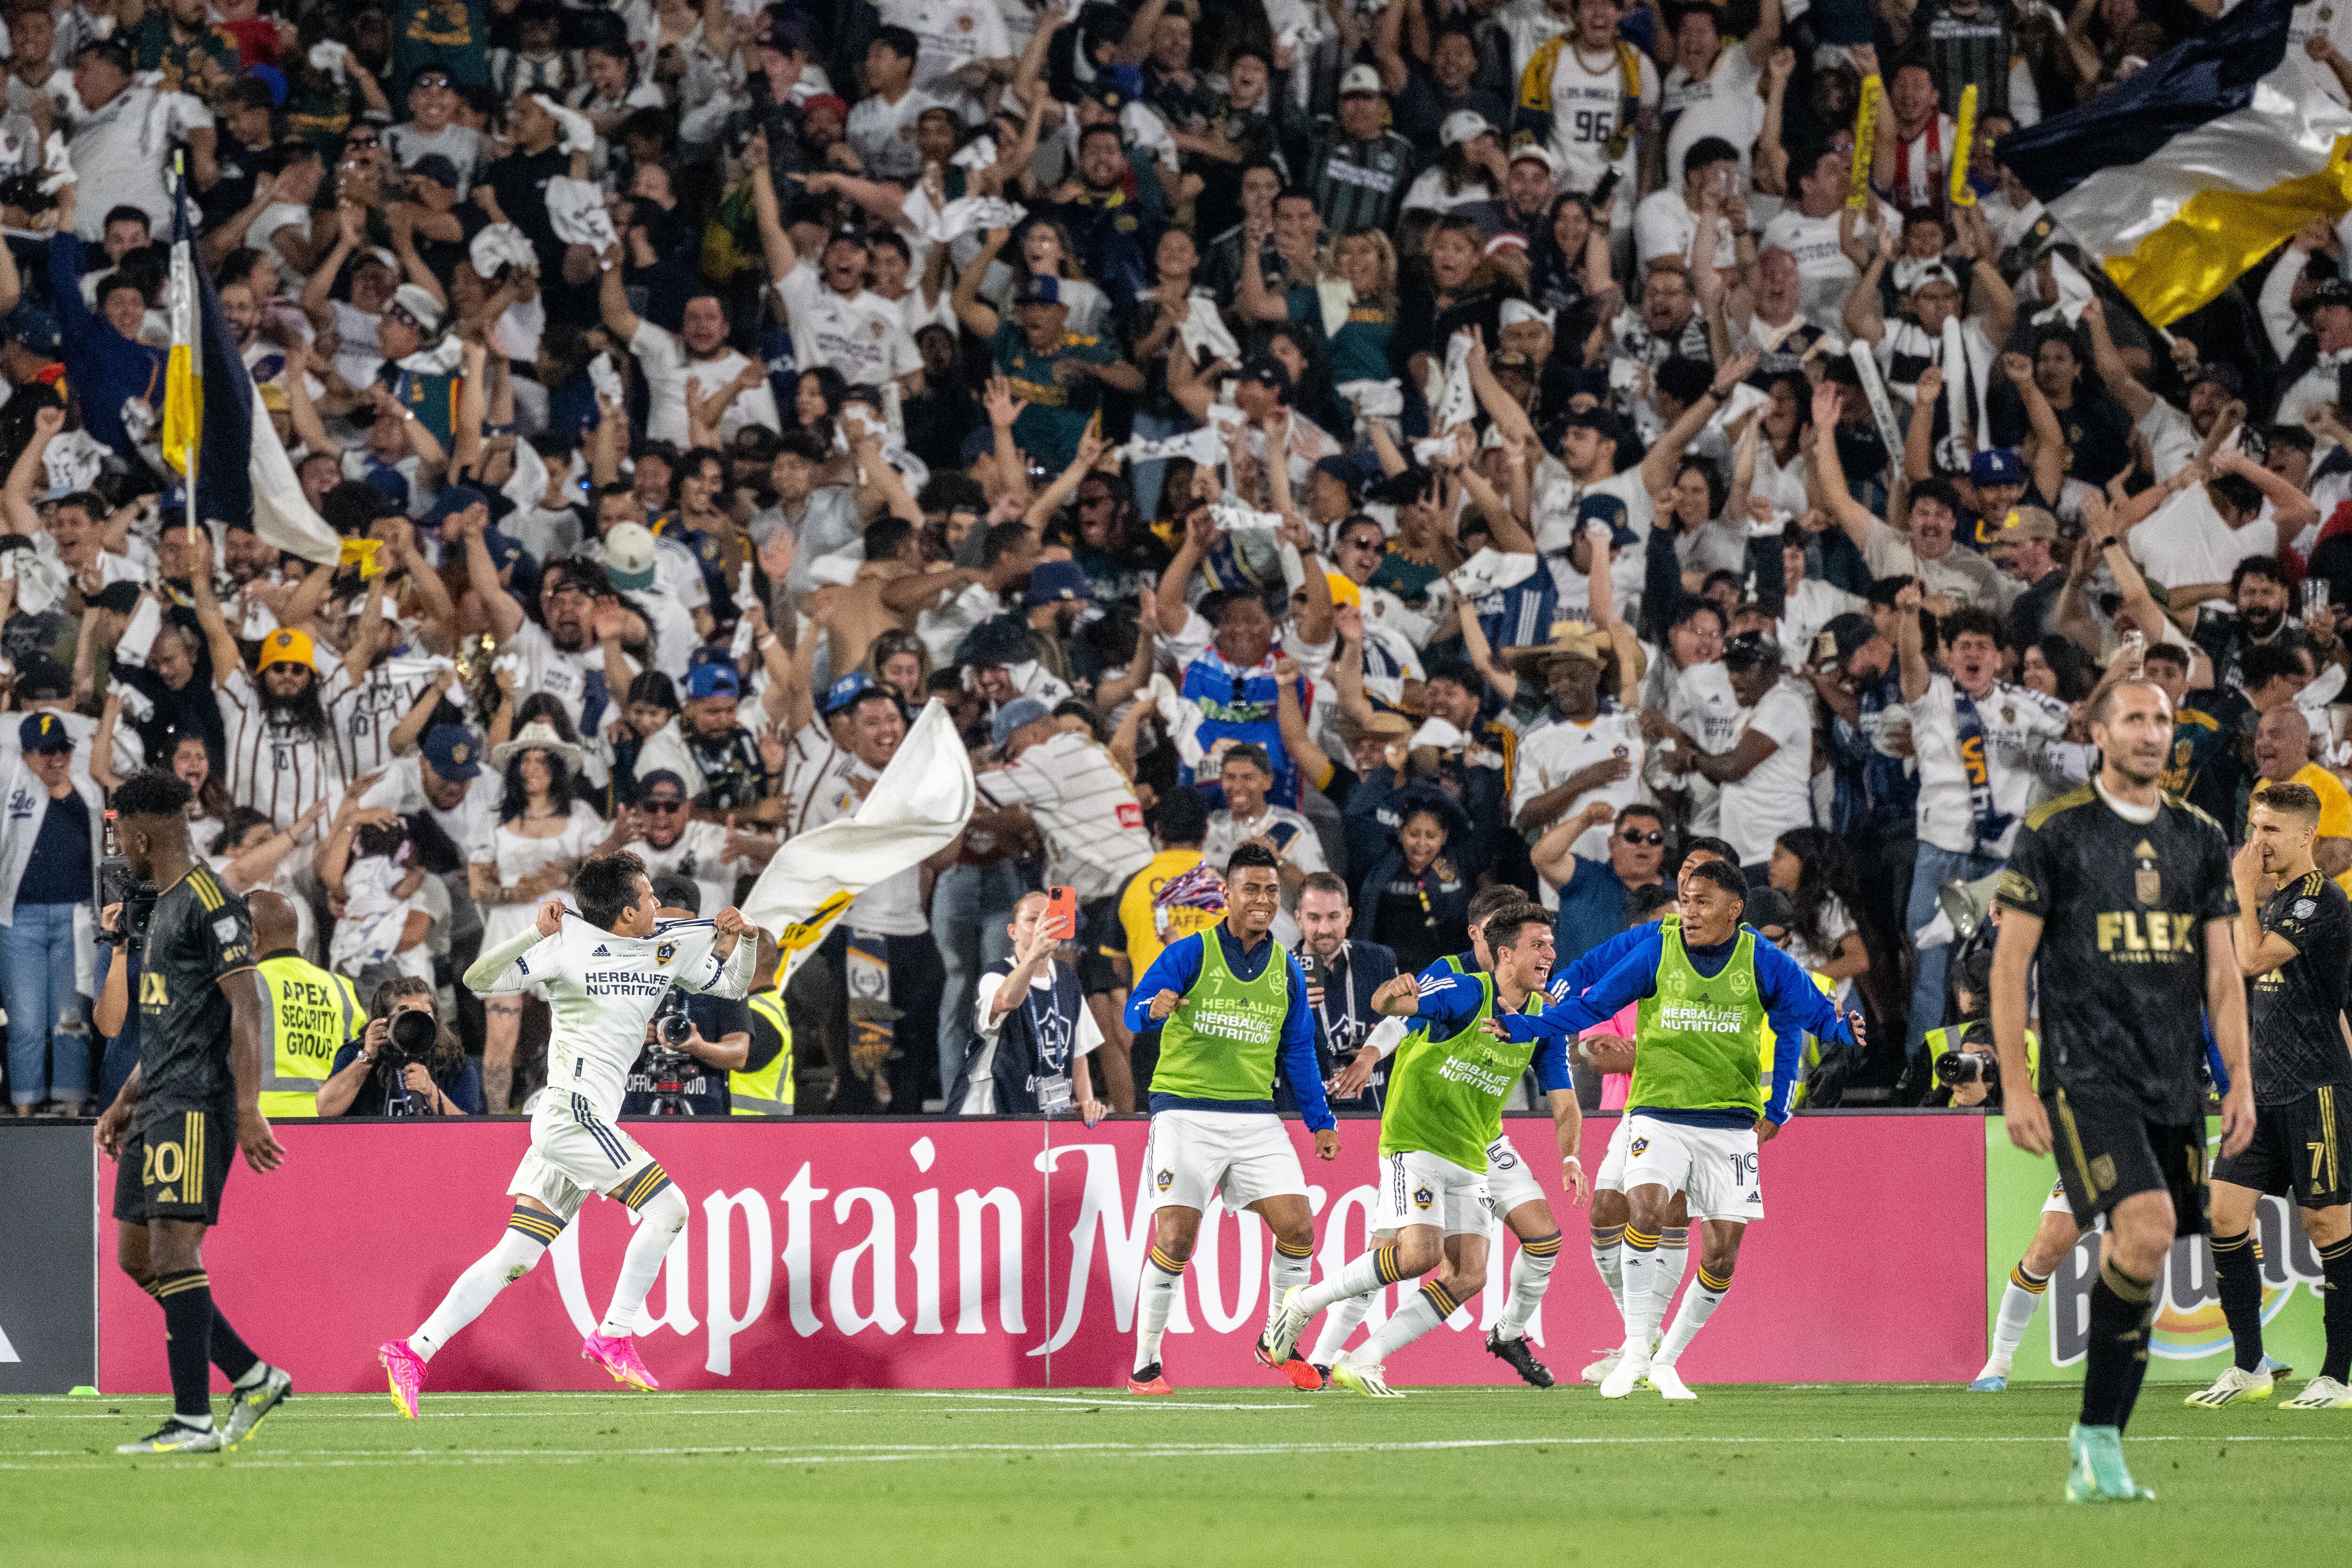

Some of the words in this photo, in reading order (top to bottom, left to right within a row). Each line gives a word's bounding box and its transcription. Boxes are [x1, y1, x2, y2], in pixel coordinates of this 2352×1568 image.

[1574, 110, 1613, 143] 96
[2097, 911, 2196, 954] FLEX
[659, 949, 670, 958] LA
[585, 971, 669, 986] HERBALIFE
[586, 984, 661, 996] NUTRITION
[1213, 979, 1223, 995] 7
[1733, 978, 1747, 987] LA
[283, 980, 332, 1008] APEX
[282, 1004, 337, 1035] SECURITY
[1195, 1010, 1274, 1034] HERBALIFE
[1661, 1018, 1741, 1034] NUTRITION
[1662, 1006, 1742, 1022] HERBALIFE
[286, 1031, 333, 1061] GROUP
[1193, 1022, 1271, 1044] NUTRITION
[1438, 1065, 1505, 1097] NUTRITION
[1446, 1055, 1511, 1087] HERBALIFE
[143, 1140, 185, 1186] 20
[1730, 1151, 1759, 1186] 19
[2306, 1142, 2325, 1179] 7
[1026, 1143, 1545, 1355] Mog
